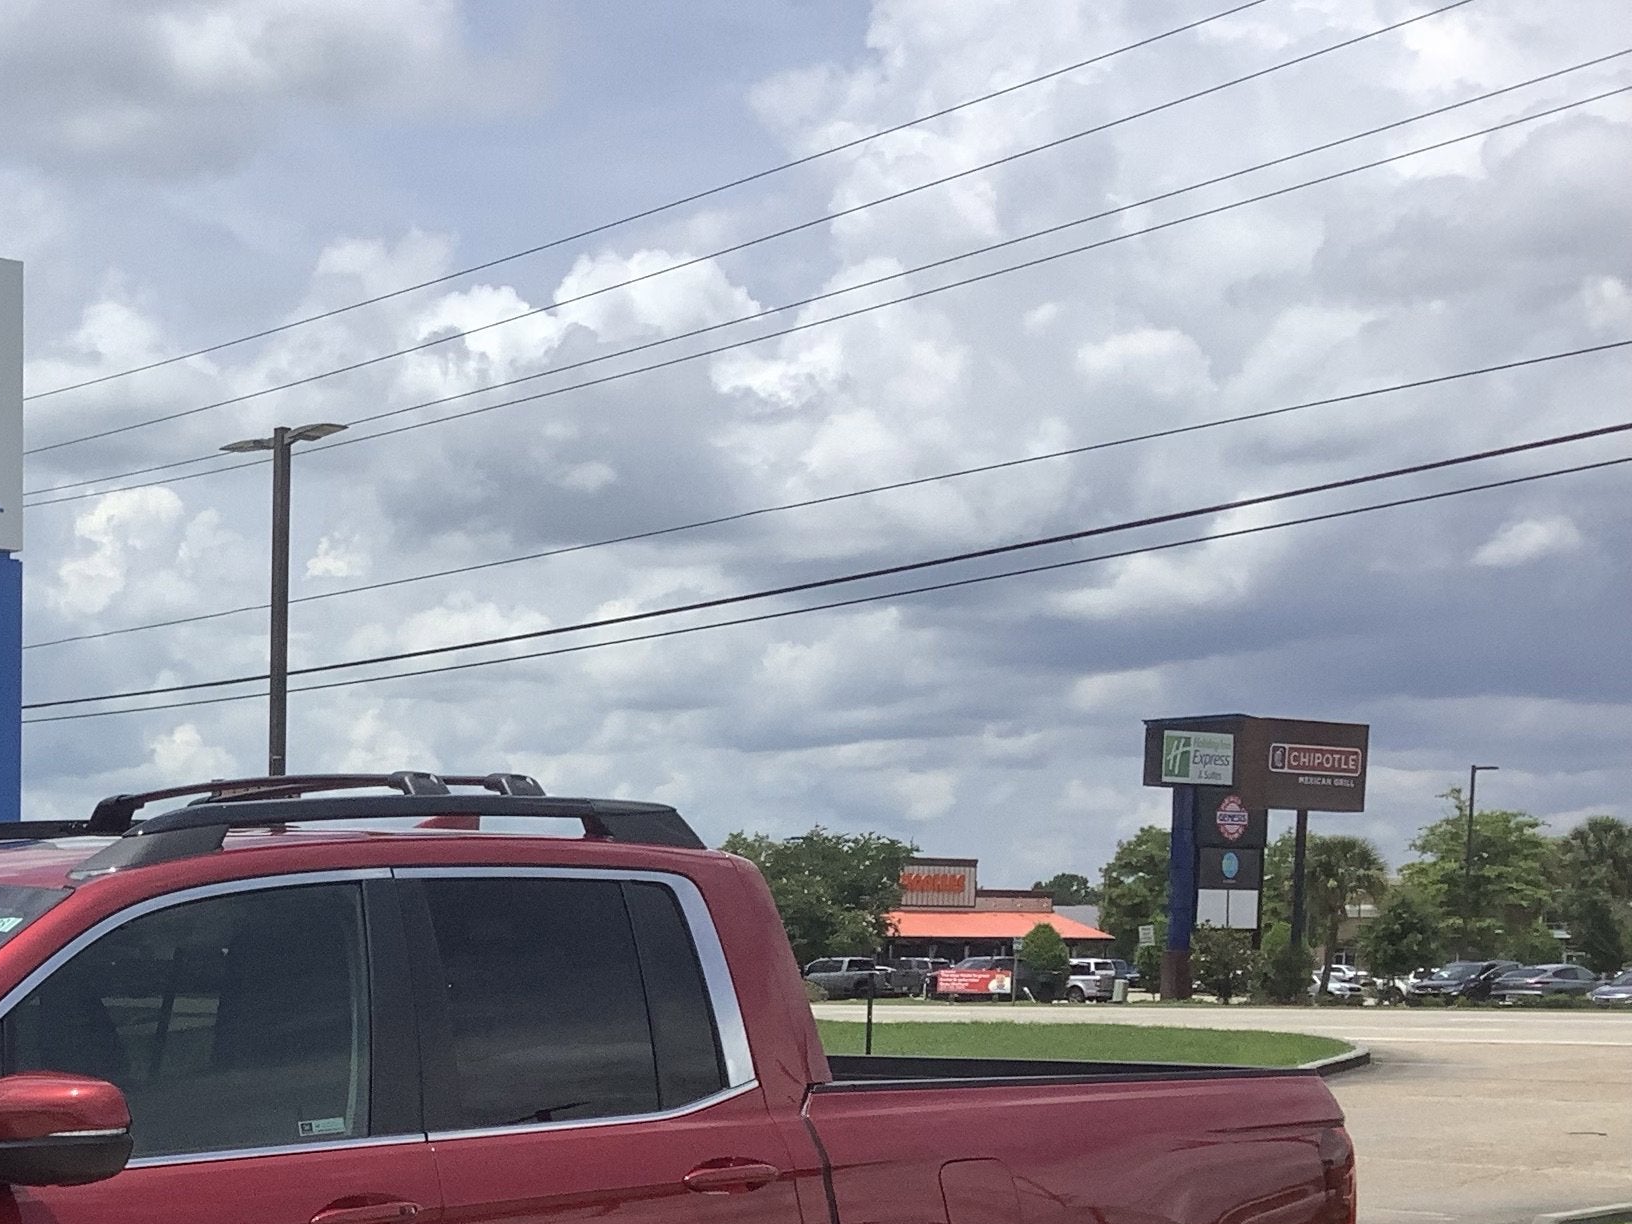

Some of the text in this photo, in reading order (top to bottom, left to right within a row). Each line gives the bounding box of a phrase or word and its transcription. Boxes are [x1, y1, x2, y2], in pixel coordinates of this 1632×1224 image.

[1192, 749, 1231, 768] Express
[1290, 751, 1357, 770] CHIPOTLE
[1298, 776, 1355, 788] MEXICAN GRILL
